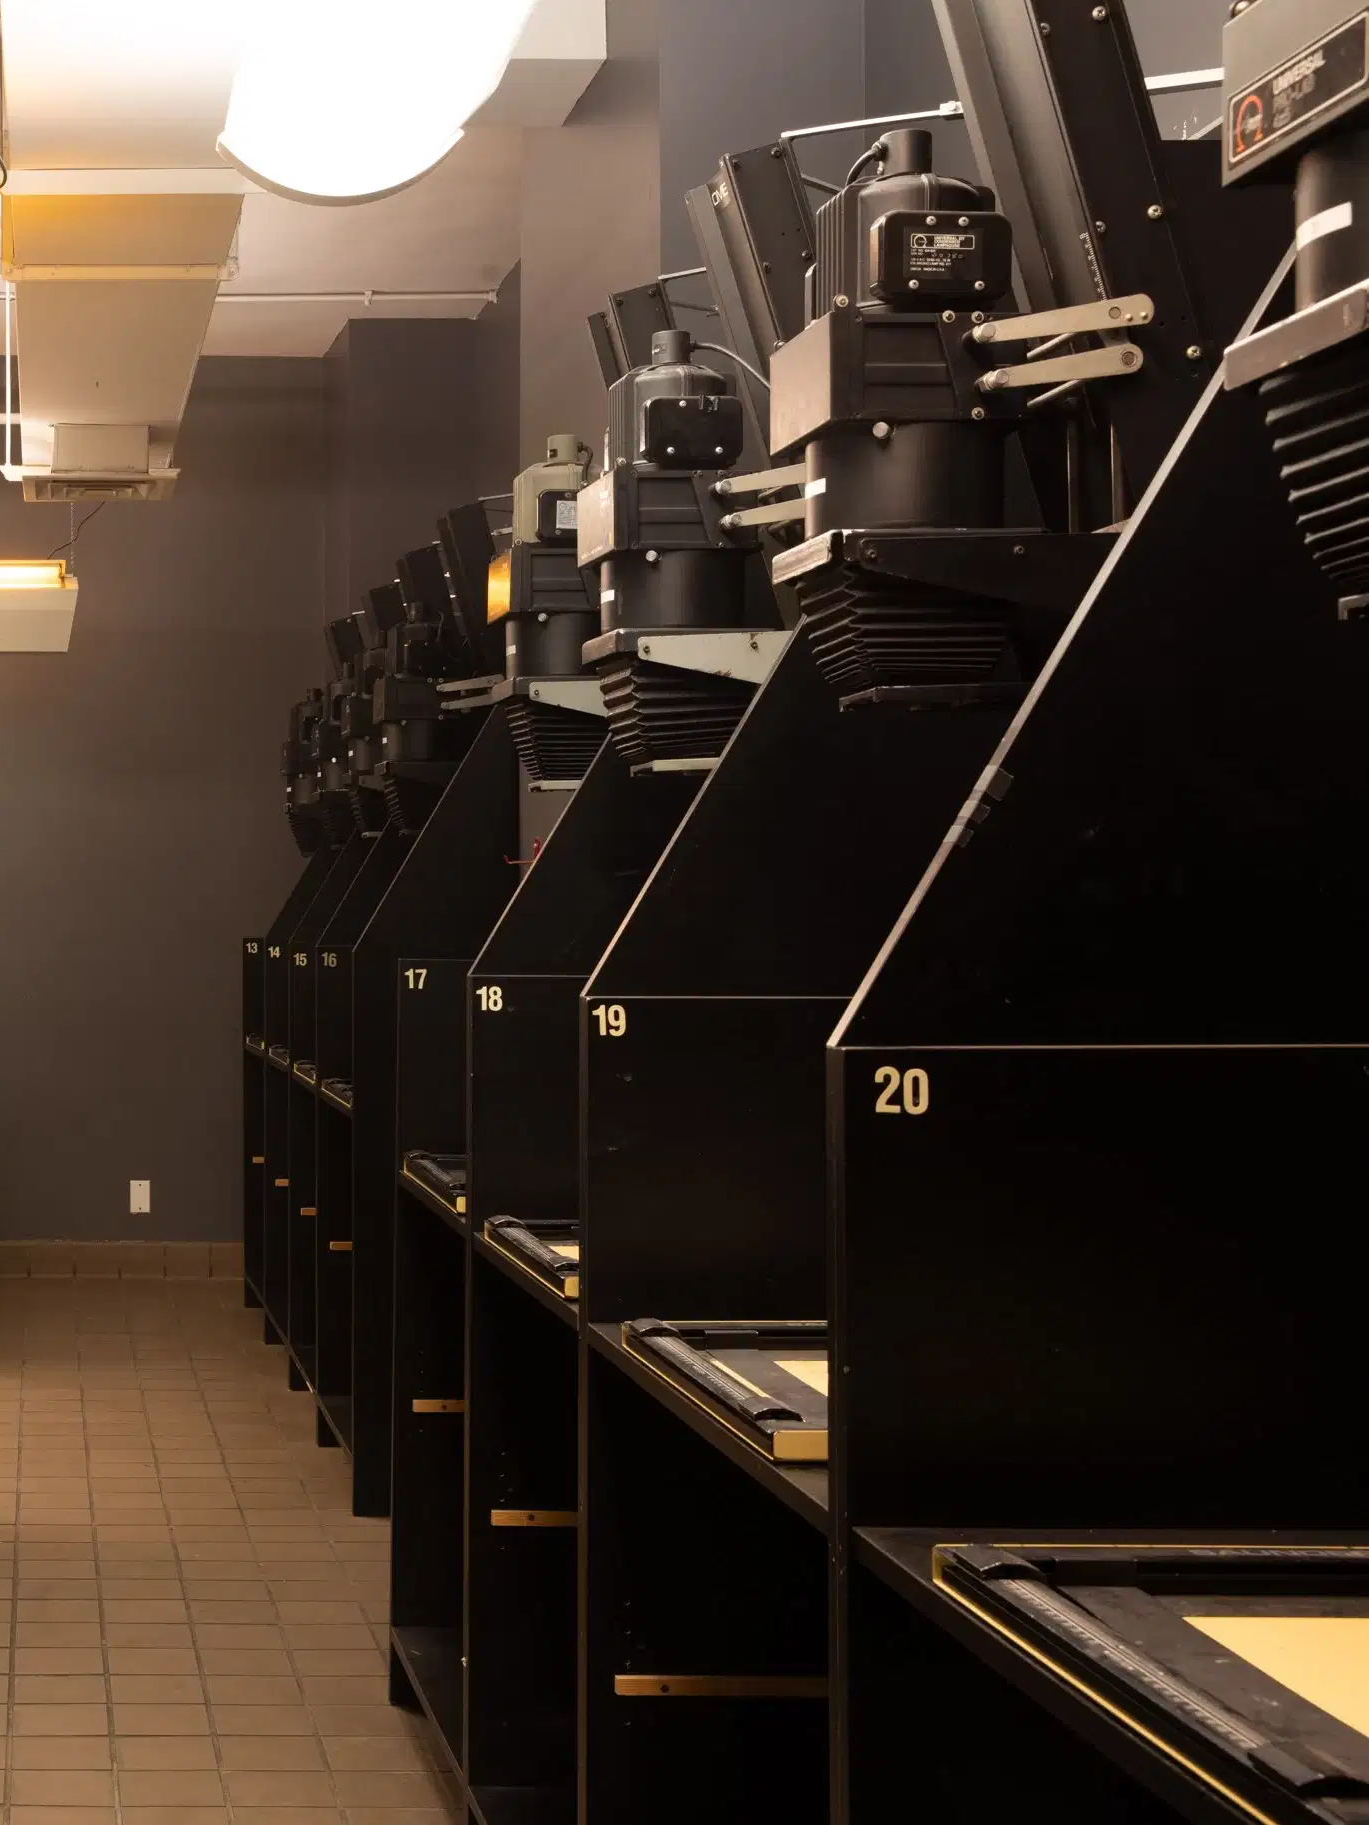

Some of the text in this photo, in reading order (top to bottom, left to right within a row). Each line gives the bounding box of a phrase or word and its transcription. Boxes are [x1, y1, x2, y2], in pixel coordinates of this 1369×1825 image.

[246, 942, 258, 953] 13
[268, 946, 280, 958] 14
[293, 952, 307, 966] 15
[321, 952, 337, 967] 16
[404, 968, 428, 989] 17
[476, 986, 503, 1011] 18
[592, 1004, 626, 1037] 19
[874, 1066, 929, 1115] 20
